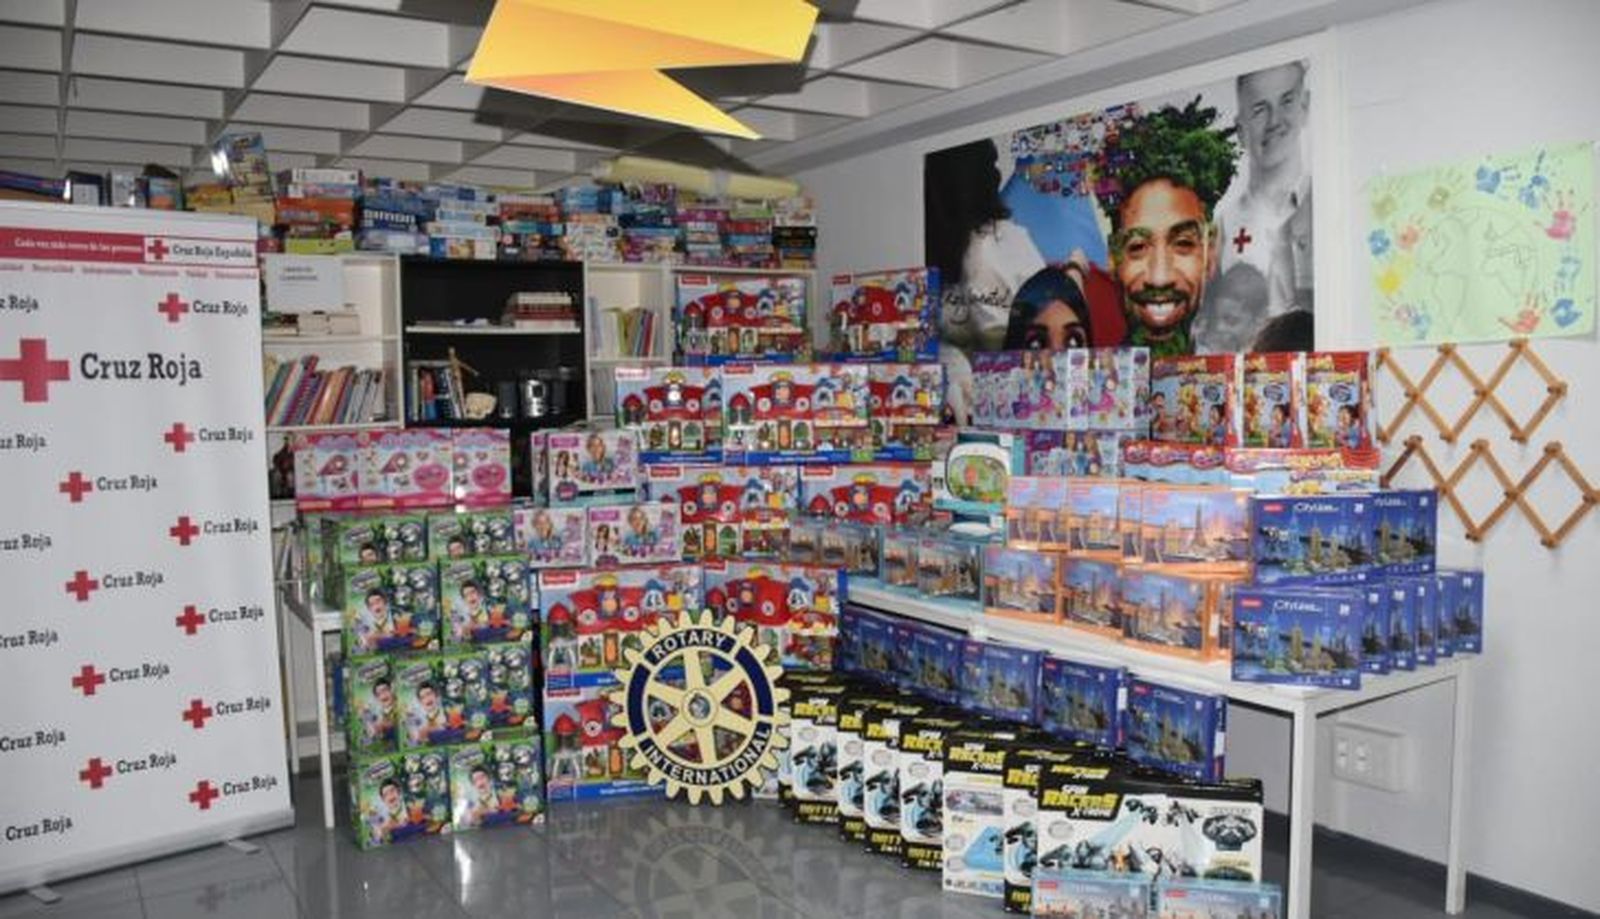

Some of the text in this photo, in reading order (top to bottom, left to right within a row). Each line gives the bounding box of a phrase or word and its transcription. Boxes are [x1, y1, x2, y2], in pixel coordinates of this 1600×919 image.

[172, 244, 253, 260] Cruz Roja Española
[8, 294, 39, 313] Roja
[193, 302, 248, 318] Cruz Roja
[80, 352, 203, 386] Cruz Roja
[15, 433, 46, 452] Roja
[198, 429, 253, 445] Cruz Roja
[96, 475, 158, 492] Cruz Roja
[204, 518, 259, 535] Cruz Roja
[21, 534, 52, 551] Roja
[102, 571, 164, 589] Cruz Roja
[208, 605, 264, 623] Cruz Roja
[27, 629, 58, 647] Roja
[653, 630, 731, 662] ROTARY
[109, 663, 170, 682] Cruz Roja
[215, 696, 271, 716] Cruz Roja
[0, 729, 66, 752] Cruz Roja
[116, 752, 176, 774] Cruz Roja
[645, 729, 770, 784] INTERNATIONAL
[223, 776, 278, 796] Cruz Roja
[5, 816, 73, 841] Cruz Roja
